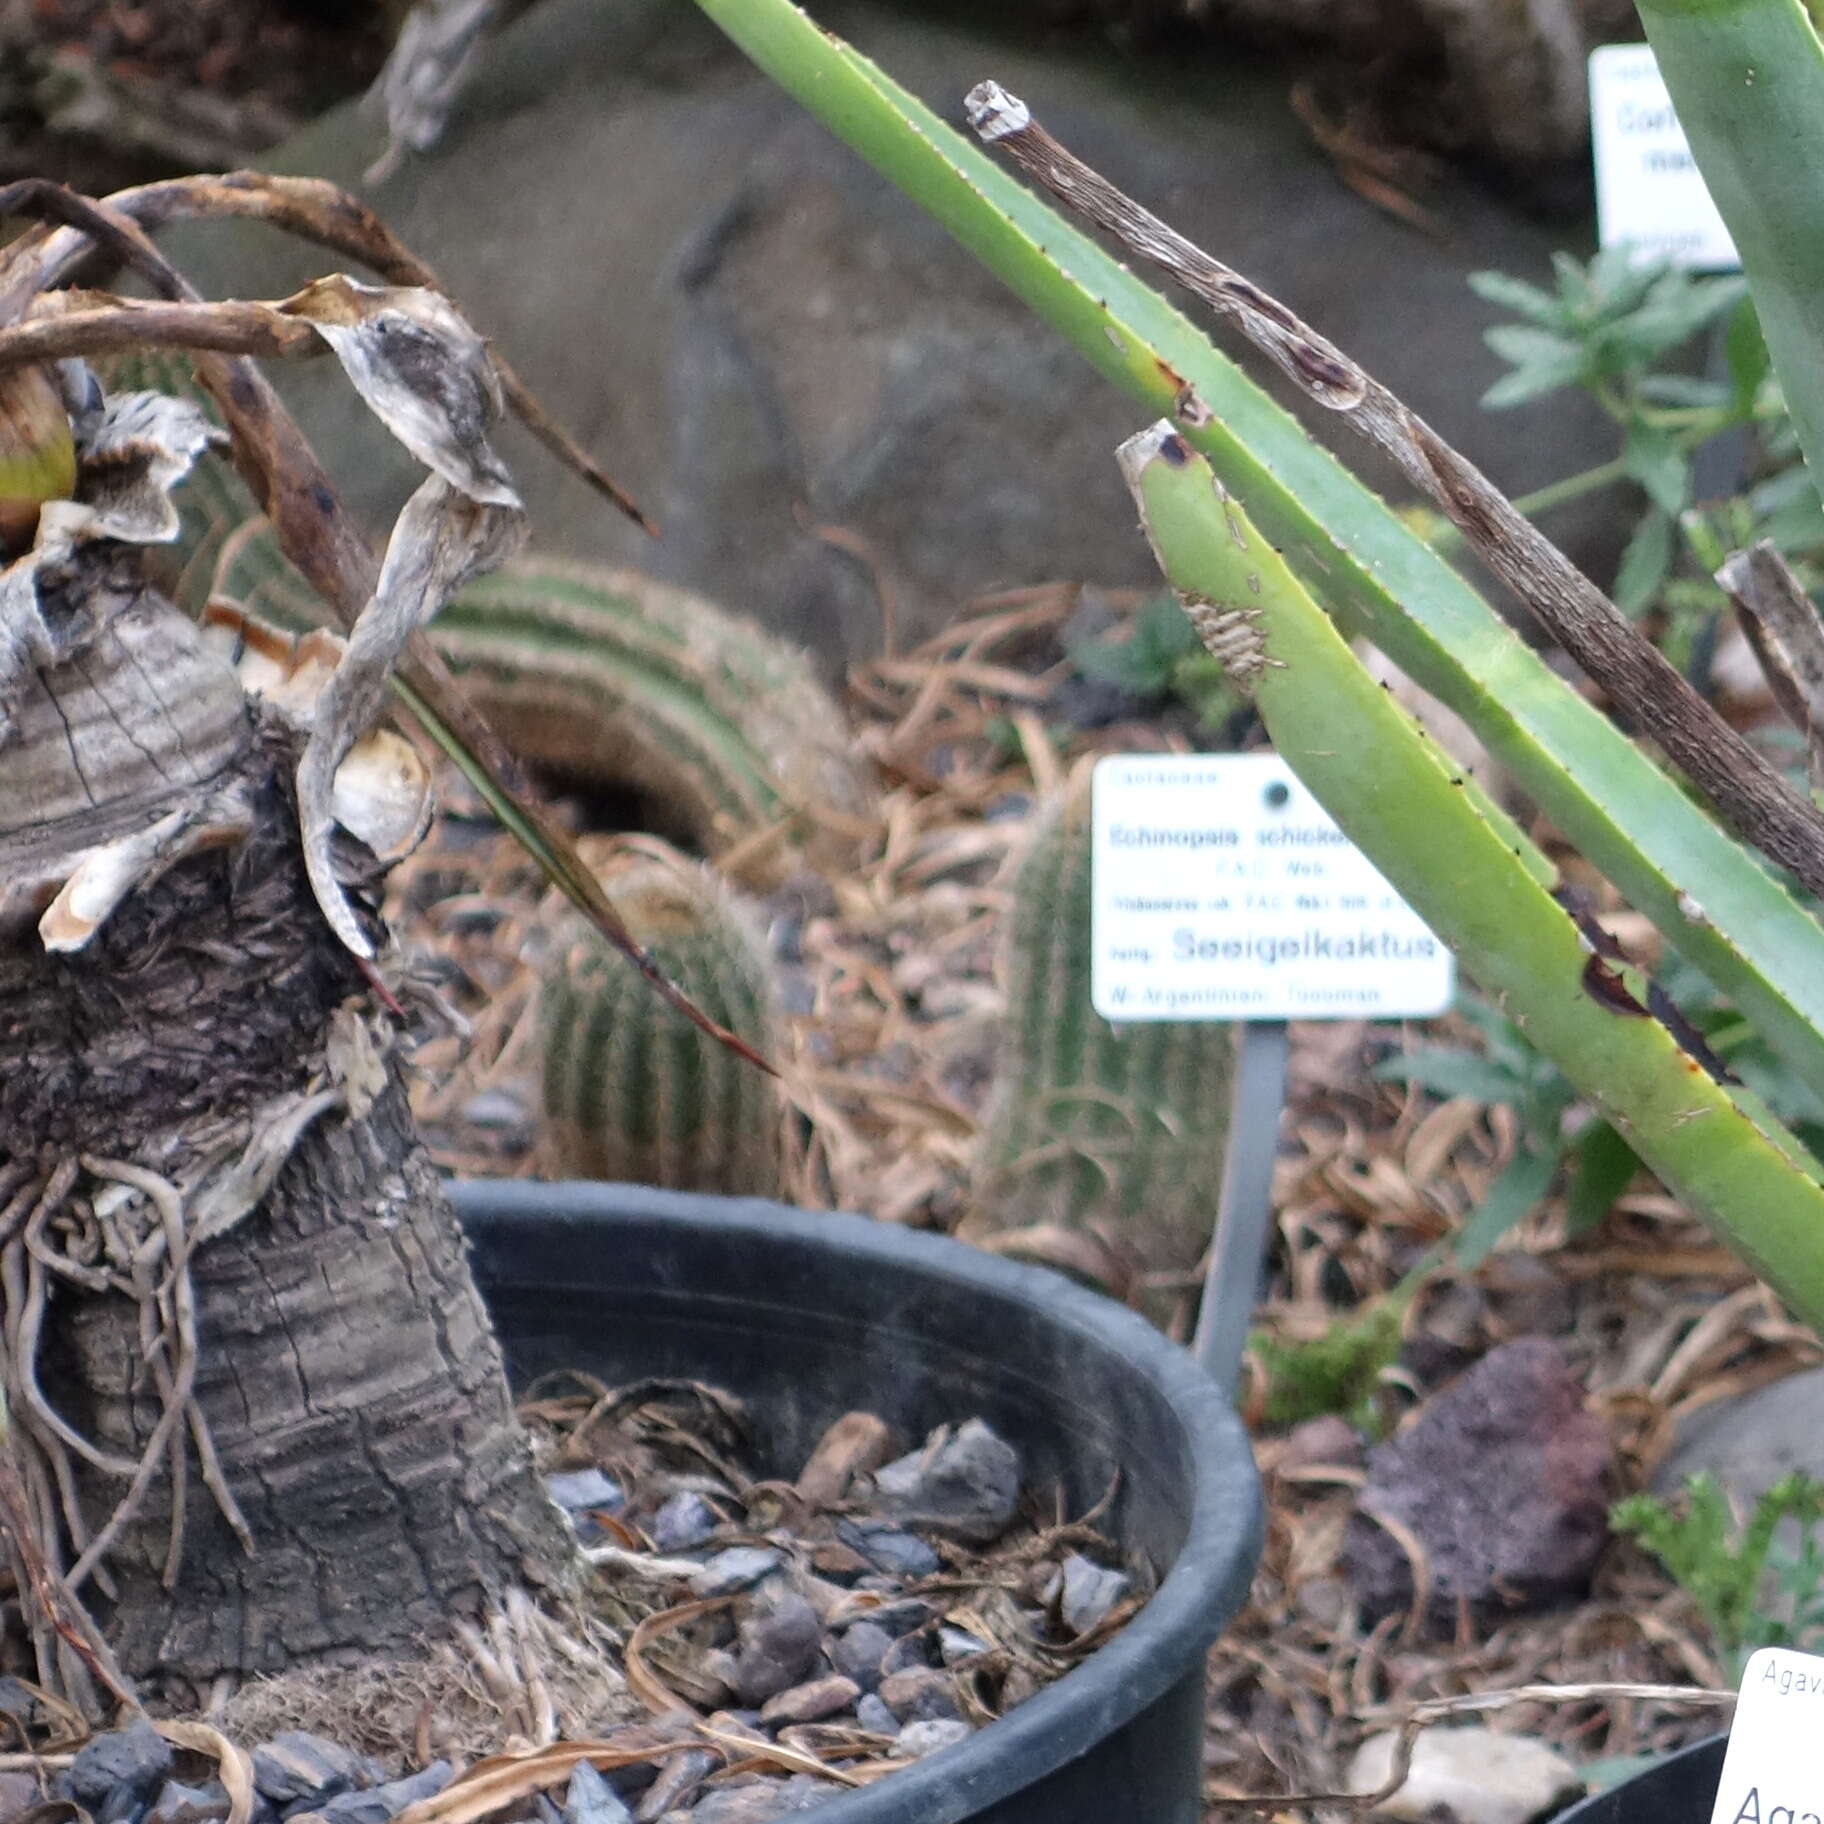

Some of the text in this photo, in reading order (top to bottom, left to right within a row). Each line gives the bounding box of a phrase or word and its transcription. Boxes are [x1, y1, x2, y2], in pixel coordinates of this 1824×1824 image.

[1109, 823, 1353, 852] Echinopsis schicke
[1171, 926, 1437, 966] Seeigelkaktus
